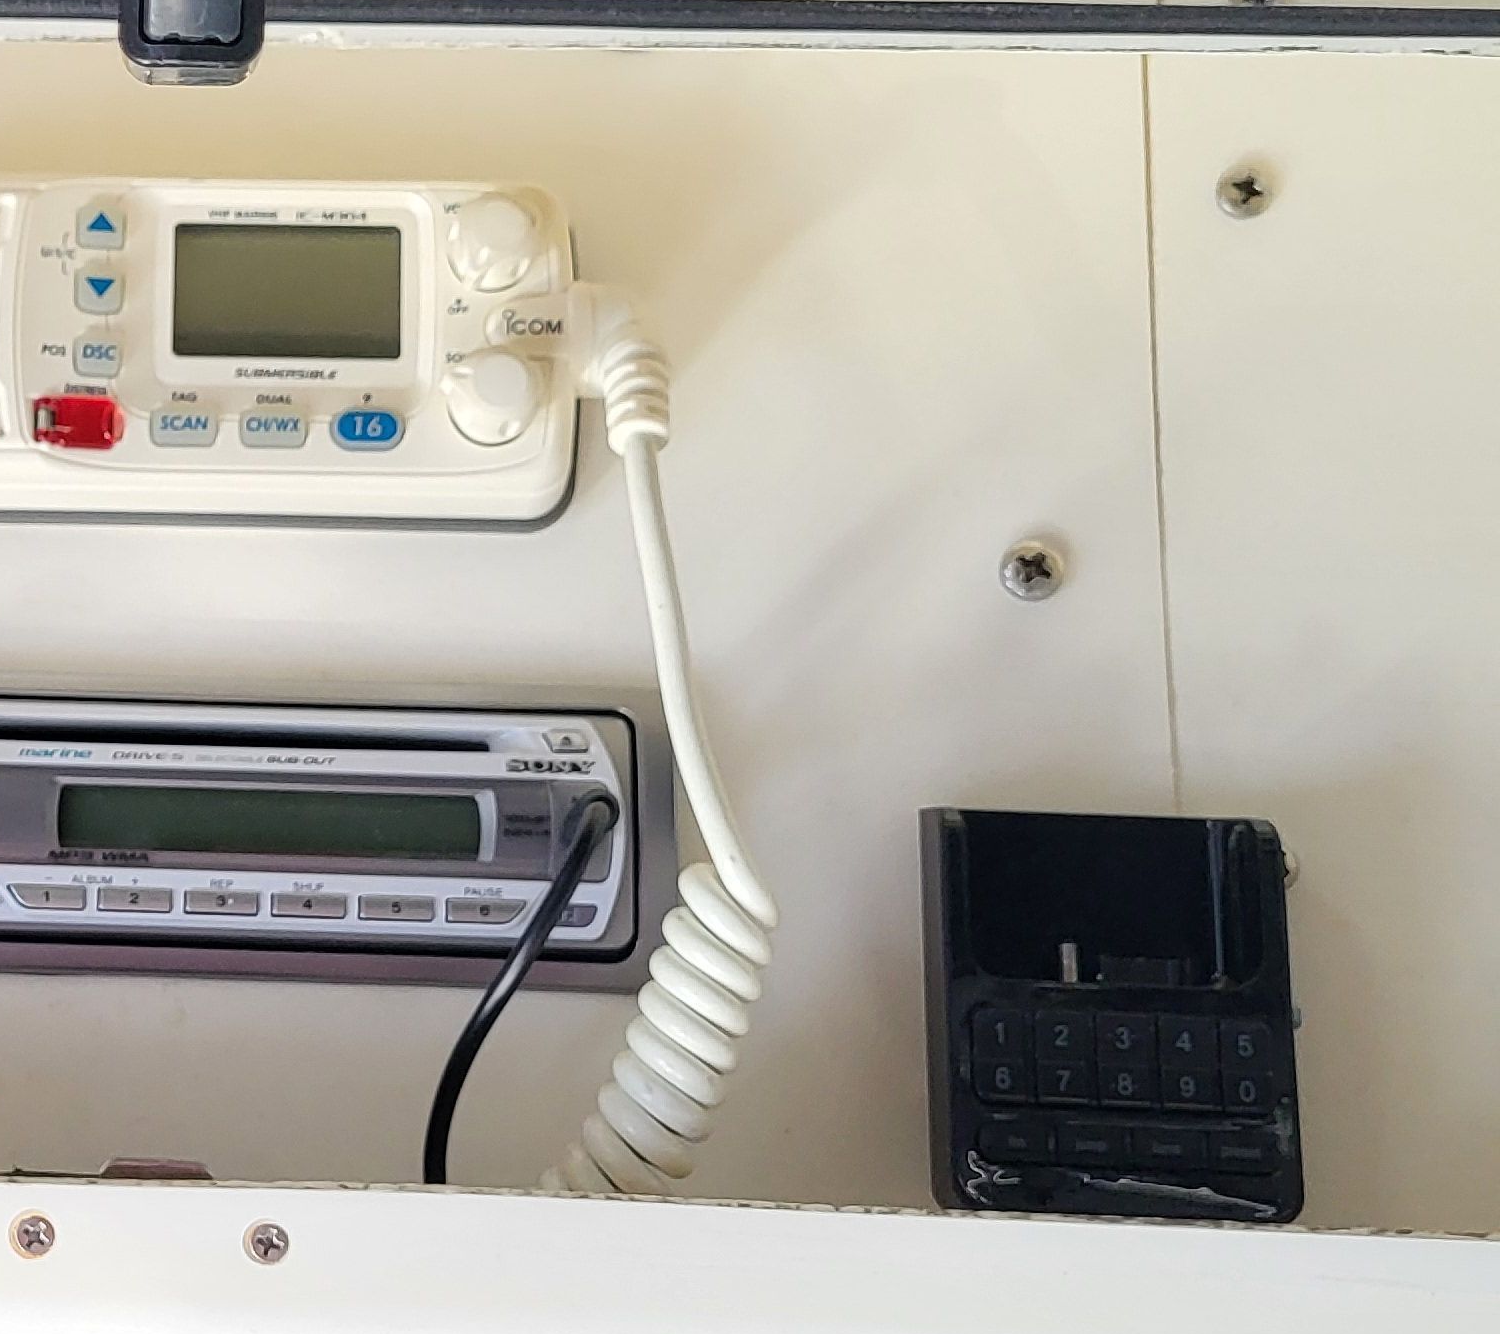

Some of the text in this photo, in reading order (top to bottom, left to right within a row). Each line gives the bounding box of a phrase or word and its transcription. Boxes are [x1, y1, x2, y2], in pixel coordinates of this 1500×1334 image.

[82, 344, 117, 361] DSC
[234, 367, 339, 380] SUBMERSIBLE
[255, 393, 293, 405] DUAL
[159, 415, 208, 431] SCAN
[245, 417, 299, 432] CH/WX
[353, 415, 384, 437] 16
[18, 747, 93, 759] marine
[266, 755, 299, 765] SUB
[303, 756, 337, 766] OUT
[506, 758, 596, 775] SONY
[43, 890, 51, 903] 1
[129, 892, 140, 905] 2
[215, 895, 227, 908] 3
[302, 898, 313, 910] 4
[391, 901, 402, 914] 5
[479, 904, 491, 917] 6
[995, 1021, 1005, 1045] 1
[1053, 1024, 1070, 1047] 2
[1114, 1026, 1132, 1049] 3
[1175, 1030, 1194, 1053] 4
[1237, 1034, 1255, 1057] 5
[995, 1066, 1012, 1090] 6
[1056, 1069, 1072, 1092] 7
[1116, 1072, 1134, 1096] 8
[1178, 1075, 1197, 1098] 9
[1238, 1080, 1257, 1103] 0
